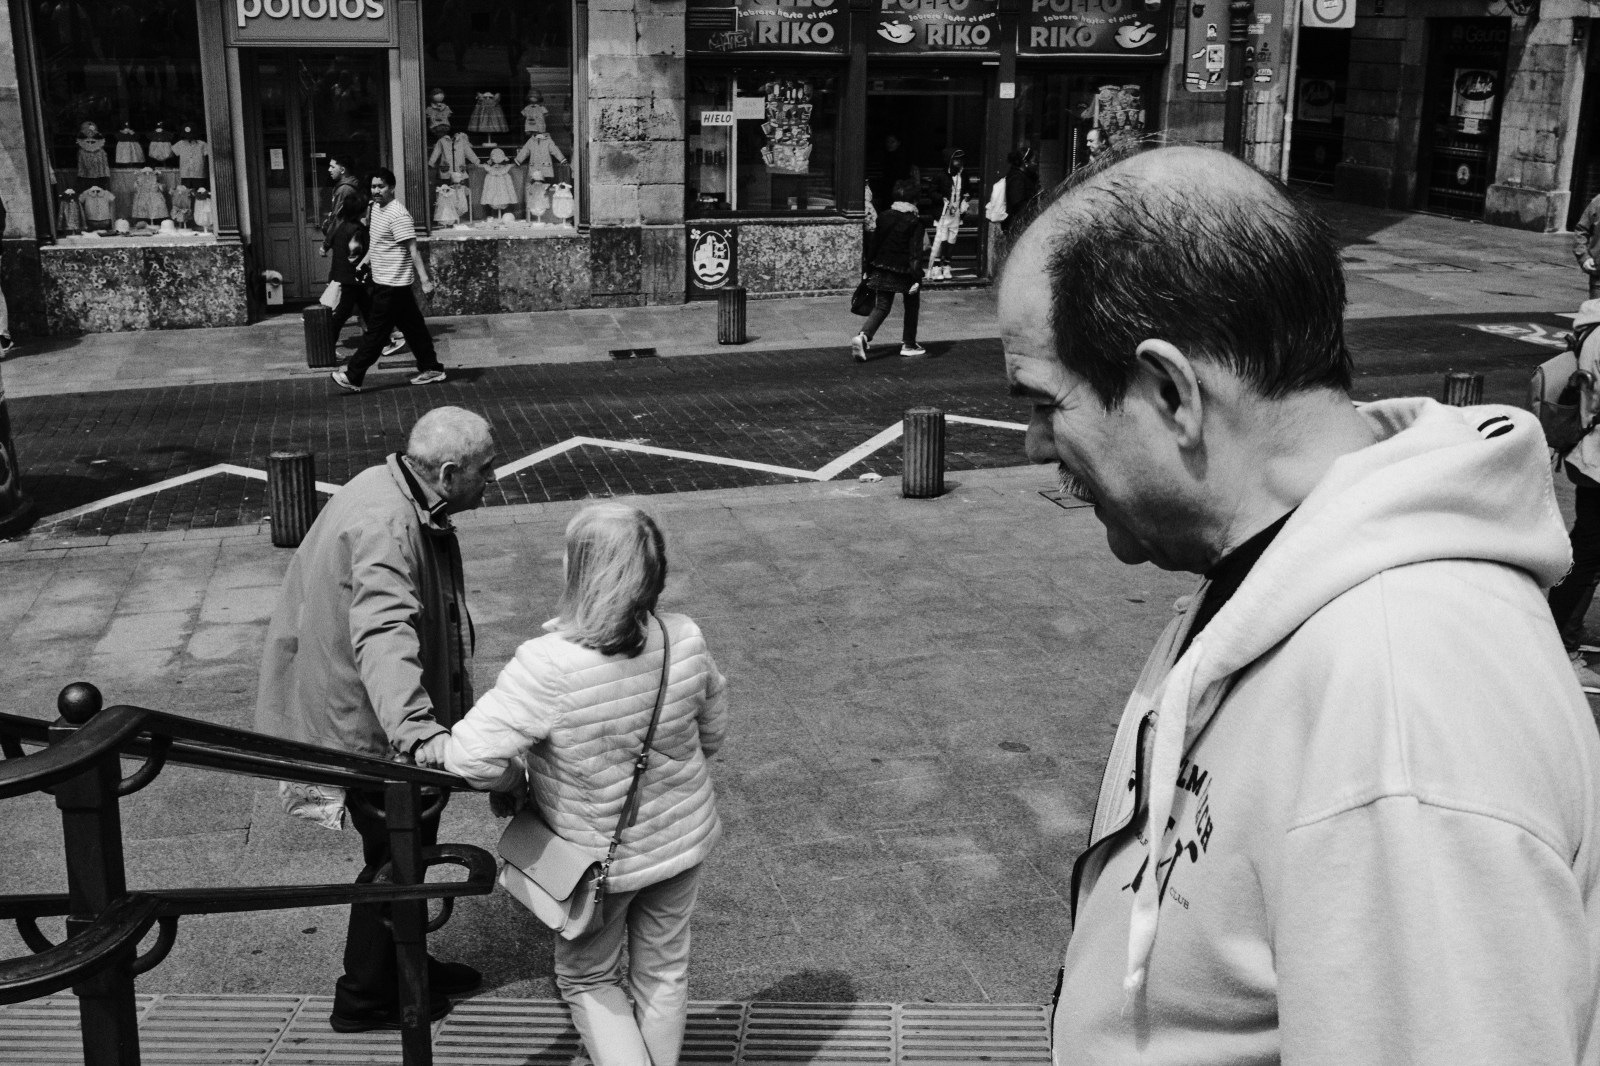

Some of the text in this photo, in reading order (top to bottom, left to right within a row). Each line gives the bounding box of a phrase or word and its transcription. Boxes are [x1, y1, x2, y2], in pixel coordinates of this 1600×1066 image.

[758, 21, 835, 45] RIKO
[927, 24, 991, 46] RIKO
[1030, 26, 1098, 48] RIKO
[703, 114, 732, 123] HIELO
[1169, 886, 1190, 910] CLUB
